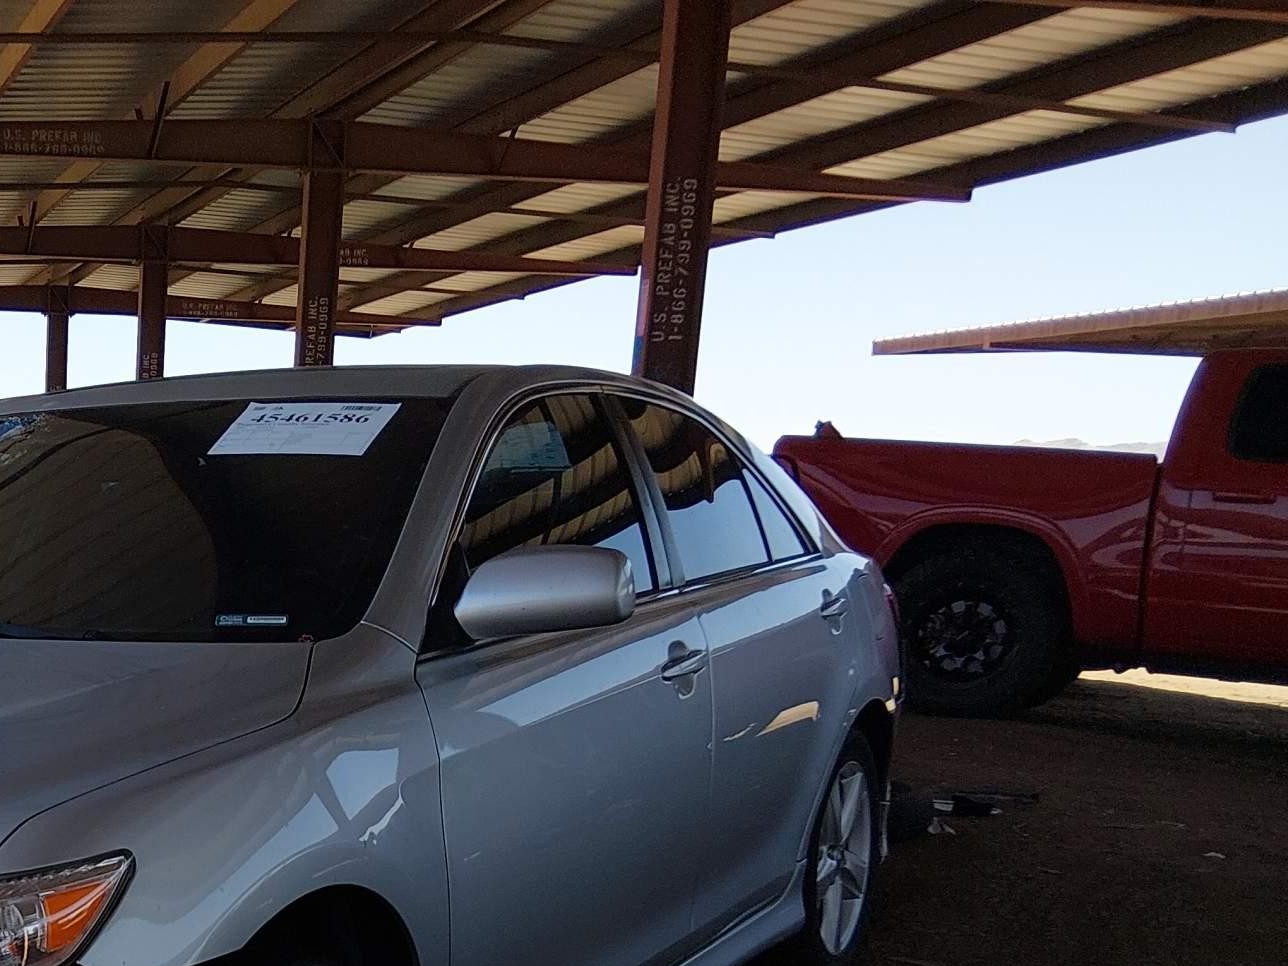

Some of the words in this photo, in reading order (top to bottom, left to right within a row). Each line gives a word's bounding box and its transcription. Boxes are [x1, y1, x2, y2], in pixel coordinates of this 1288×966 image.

[664, 176, 682, 212] INC.
[656, 223, 677, 296] PREFAB
[668, 178, 698, 341] 1-866-799-0969
[651, 305, 668, 342] U.S.
[251, 413, 370, 424] 45461586
